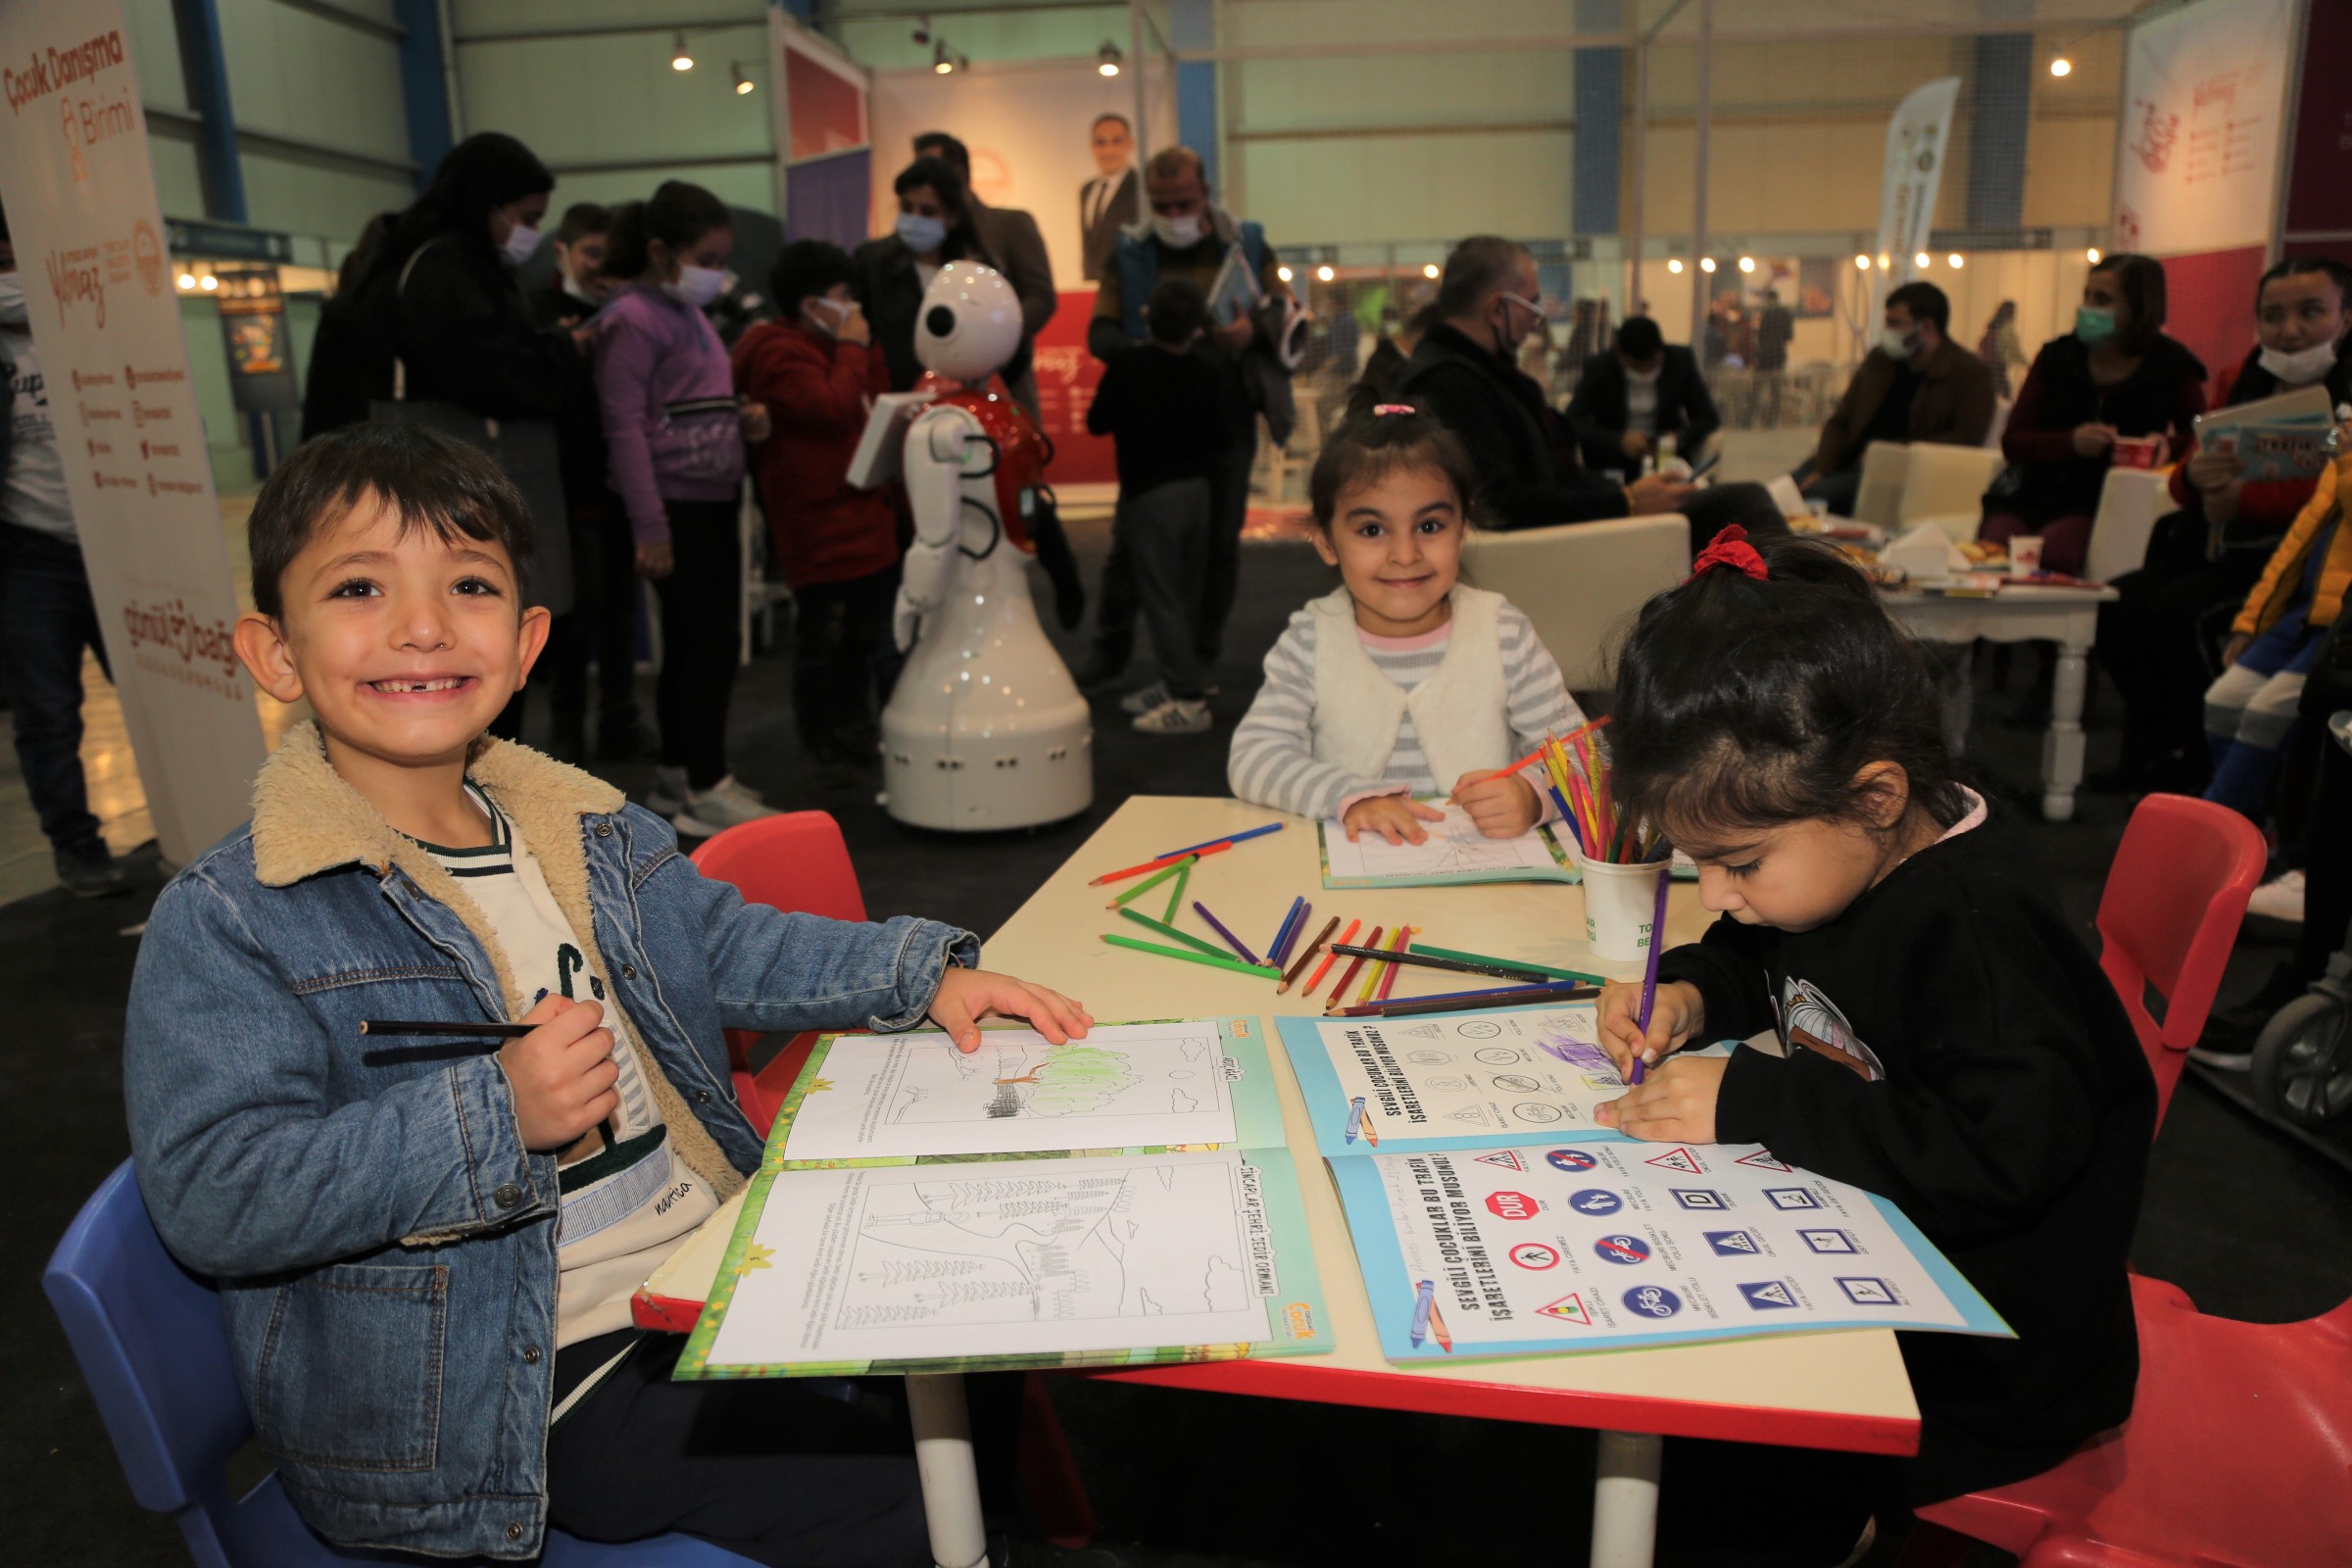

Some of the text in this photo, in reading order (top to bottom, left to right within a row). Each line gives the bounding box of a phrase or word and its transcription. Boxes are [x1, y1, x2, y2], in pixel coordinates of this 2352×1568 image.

[48, 29, 123, 91] Danışma
[79, 87, 135, 144] Birimi
[1639, 923, 1653, 934] TO
[1637, 937, 1650, 948] BE
[1344, 1030, 1367, 1048] TRAFİK
[1360, 1058, 1393, 1087] ÇOCUKLAR
[1379, 1055, 1403, 1076] BİLİYOR
[1373, 1089, 1401, 1116] SEVGİLİ
[1388, 1077, 1429, 1123] İŞARETLERİNİ
[1698, 1160, 1711, 1172] OKUL
[655, 1182, 693, 1216] nautica
[1241, 1167, 1260, 1208] SİNCAPLAR
[1632, 1186, 1644, 1199] YOLU
[1685, 1195, 1710, 1203] D
[1721, 1192, 1736, 1206] DURAK
[1497, 1194, 1527, 1217] DUR
[1540, 1200, 1548, 1210] DUR
[1450, 1201, 1482, 1242] BİLİYOR
[1405, 1158, 1480, 1310] SEVGİLİ ÇOCUKLAR BU TRAFİK
[1660, 1230, 1682, 1260] YOLU SONU
[1250, 1237, 1272, 1260] SEDİR
[1657, 1247, 1677, 1270] MECBURİ
[1762, 1244, 1776, 1257] OKUL
[1255, 1262, 1275, 1295] ORMANI
[1461, 1246, 1514, 1321] İŞARETLERİNİ
[1689, 1277, 1701, 1292] YOLU
[1682, 1285, 1700, 1311] MECBURİ
[1798, 1294, 1814, 1310] YAYA
